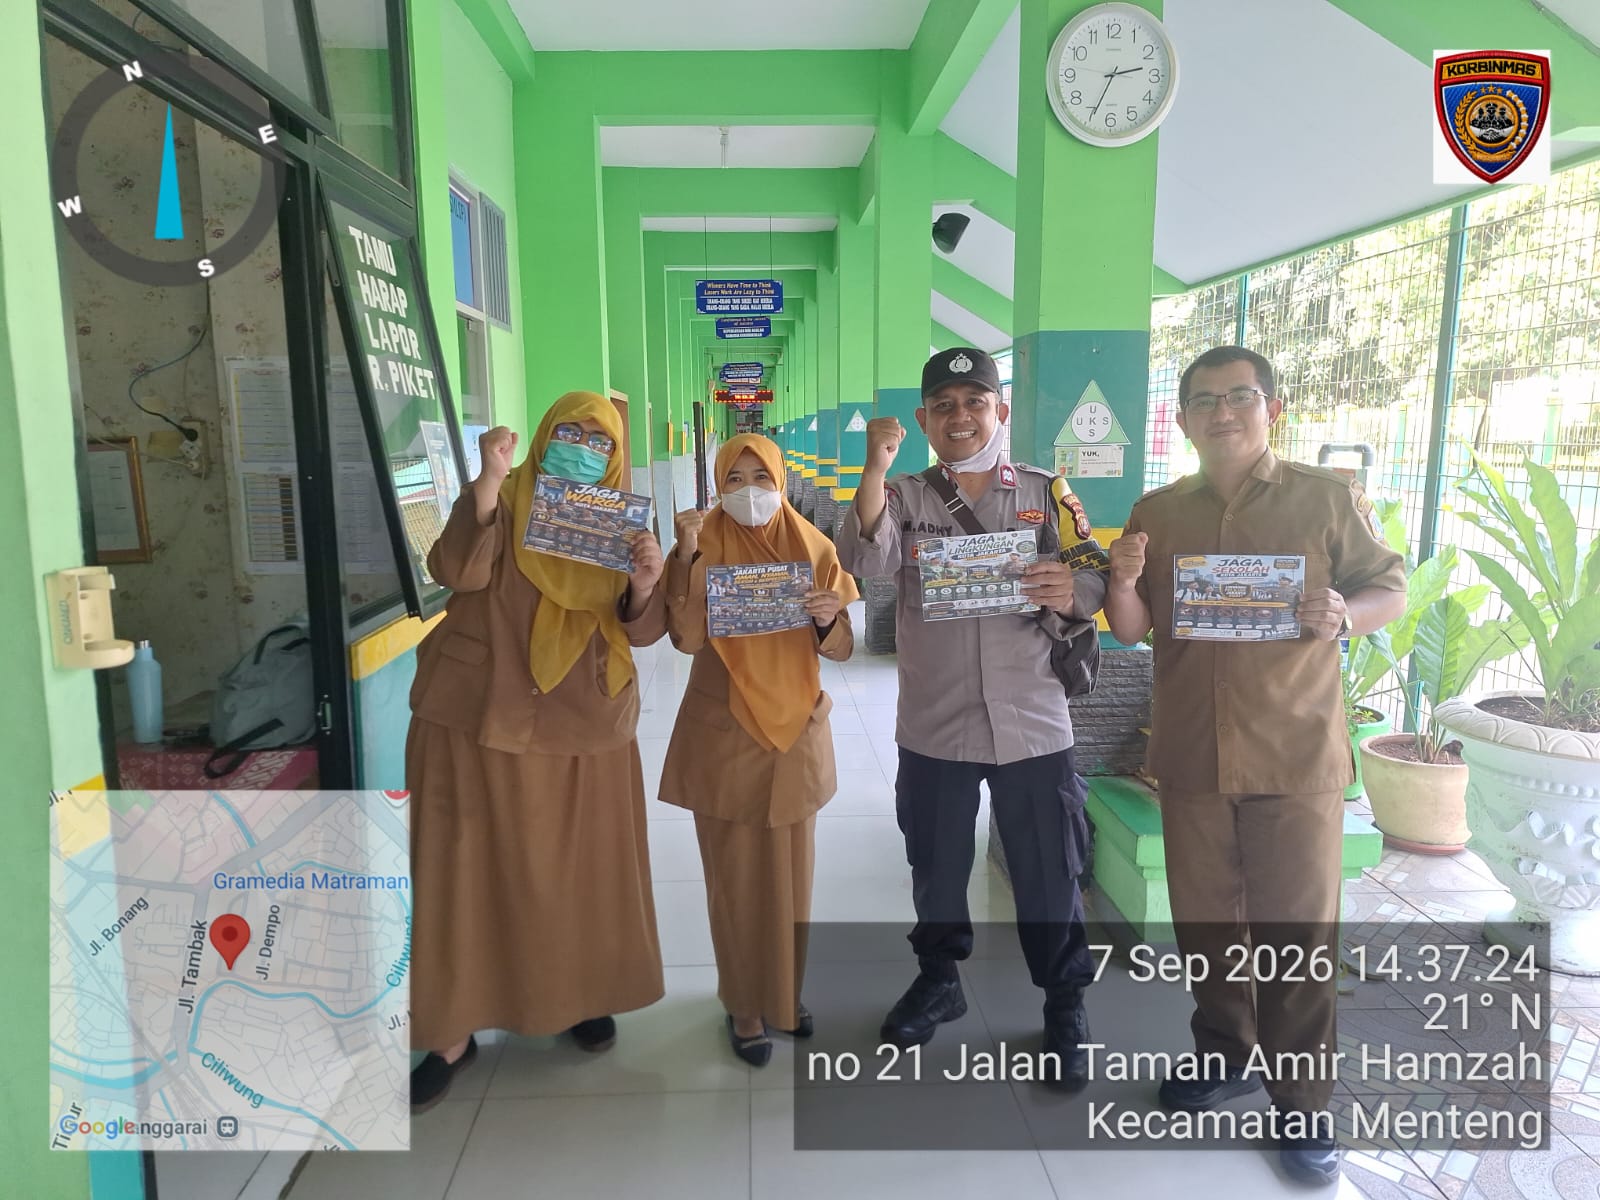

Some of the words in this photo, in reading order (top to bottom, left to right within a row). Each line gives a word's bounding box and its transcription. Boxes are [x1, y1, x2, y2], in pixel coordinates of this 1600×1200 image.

[1089, 30, 1098, 44] 11
[1106, 24, 1122, 39] 12
[1132, 29, 1136, 43] 1
[1072, 46, 1087, 61] 10
[1143, 45, 1154, 60] 2
[1064, 68, 1076, 83] 9
[1149, 69, 1160, 83] 3
[1070, 90, 1082, 105] 8
[1142, 90, 1153, 104] 4
[1086, 107, 1097, 121] 7
[1105, 113, 1116, 127] 6
[1127, 106, 1138, 121] 5
[348, 225, 397, 276] TAMU
[356, 270, 408, 318] HARAP
[365, 313, 422, 360] LAPOR
[367, 354, 389, 392] R.
[387, 360, 436, 399] PIKET
[1089, 405, 1097, 414] U
[1076, 418, 1083, 426] U
[1089, 417, 1097, 425] K
[1102, 416, 1109, 425] S
[1089, 429, 1095, 437] S
[574, 484, 621, 501] JAGA
[566, 491, 626, 510] WARGA
[949, 540, 1014, 555] LINGKUNGAN
[959, 535, 995, 547] JAGA
[733, 567, 766, 575] JAKARTA
[767, 565, 788, 573] PUSAT
[1211, 566, 1271, 574] SEKOLAH
[1218, 559, 1263, 567] JAGA
